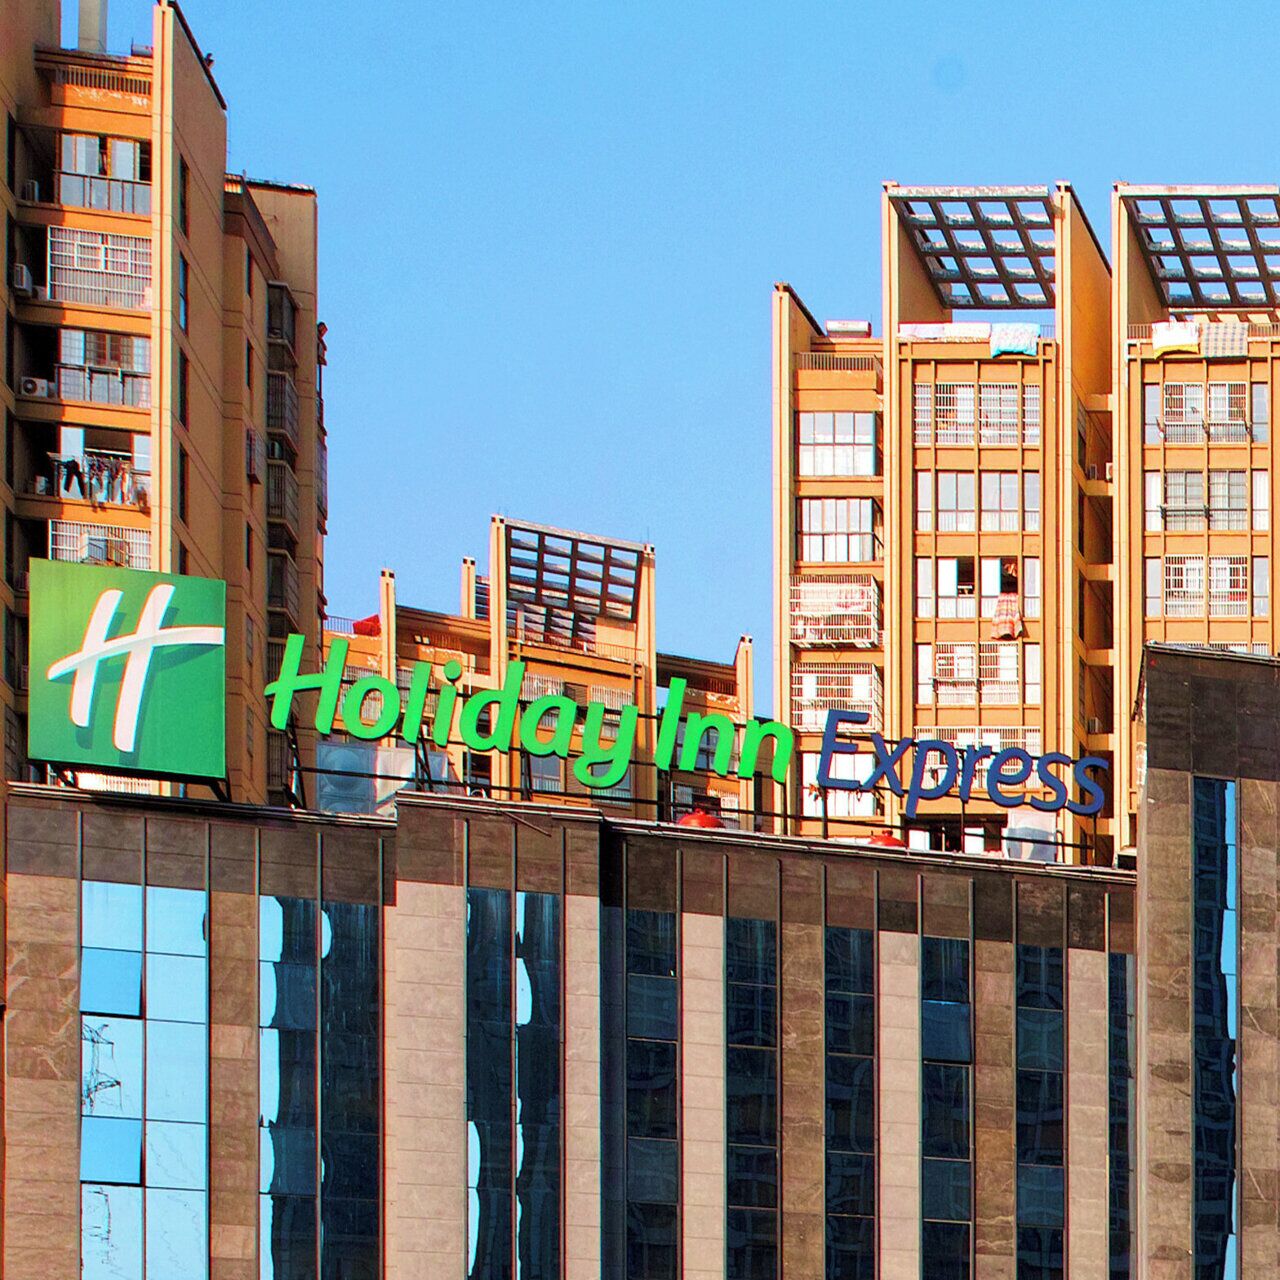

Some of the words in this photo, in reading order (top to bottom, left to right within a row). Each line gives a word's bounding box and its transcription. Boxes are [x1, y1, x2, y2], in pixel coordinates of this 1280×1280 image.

[264, 633, 638, 789] Holiday
[654, 676, 794, 784] Inn
[817, 709, 1109, 819] Express
